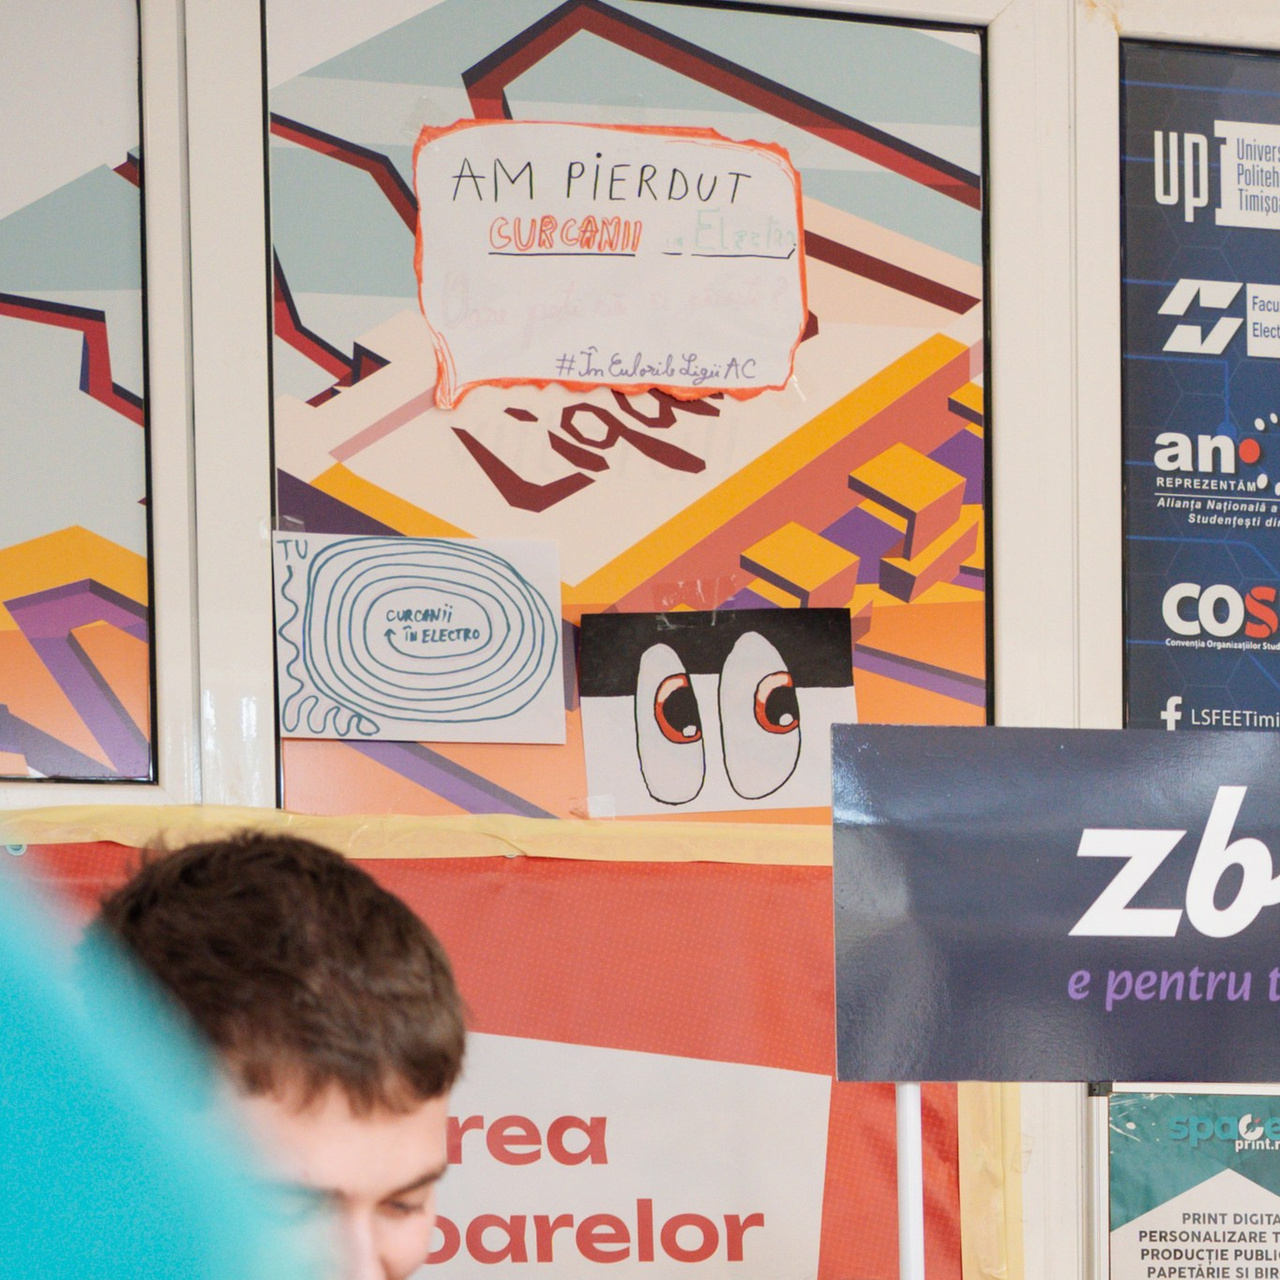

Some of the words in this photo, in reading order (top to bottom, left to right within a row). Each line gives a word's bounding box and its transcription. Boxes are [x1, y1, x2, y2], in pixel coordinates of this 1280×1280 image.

[451, 157, 535, 202] AM
[488, 214, 643, 253] CURCANII
[1156, 477, 1257, 492] REPREZENTĂM
[1157, 497, 1202, 513] Alianța
[1206, 500, 1267, 514] Națională
[422, 627, 481, 644] ELECTRO
[1067, 968, 1091, 1001] e
[1105, 966, 1253, 1012] pentru
[1182, 1212, 1228, 1225] PRINT
[1138, 1230, 1268, 1243] PERSONALIZARE
[1140, 1248, 1229, 1265] PRODUCȚIE
[1147, 1264, 1231, 1279] PAPETĂRIE
